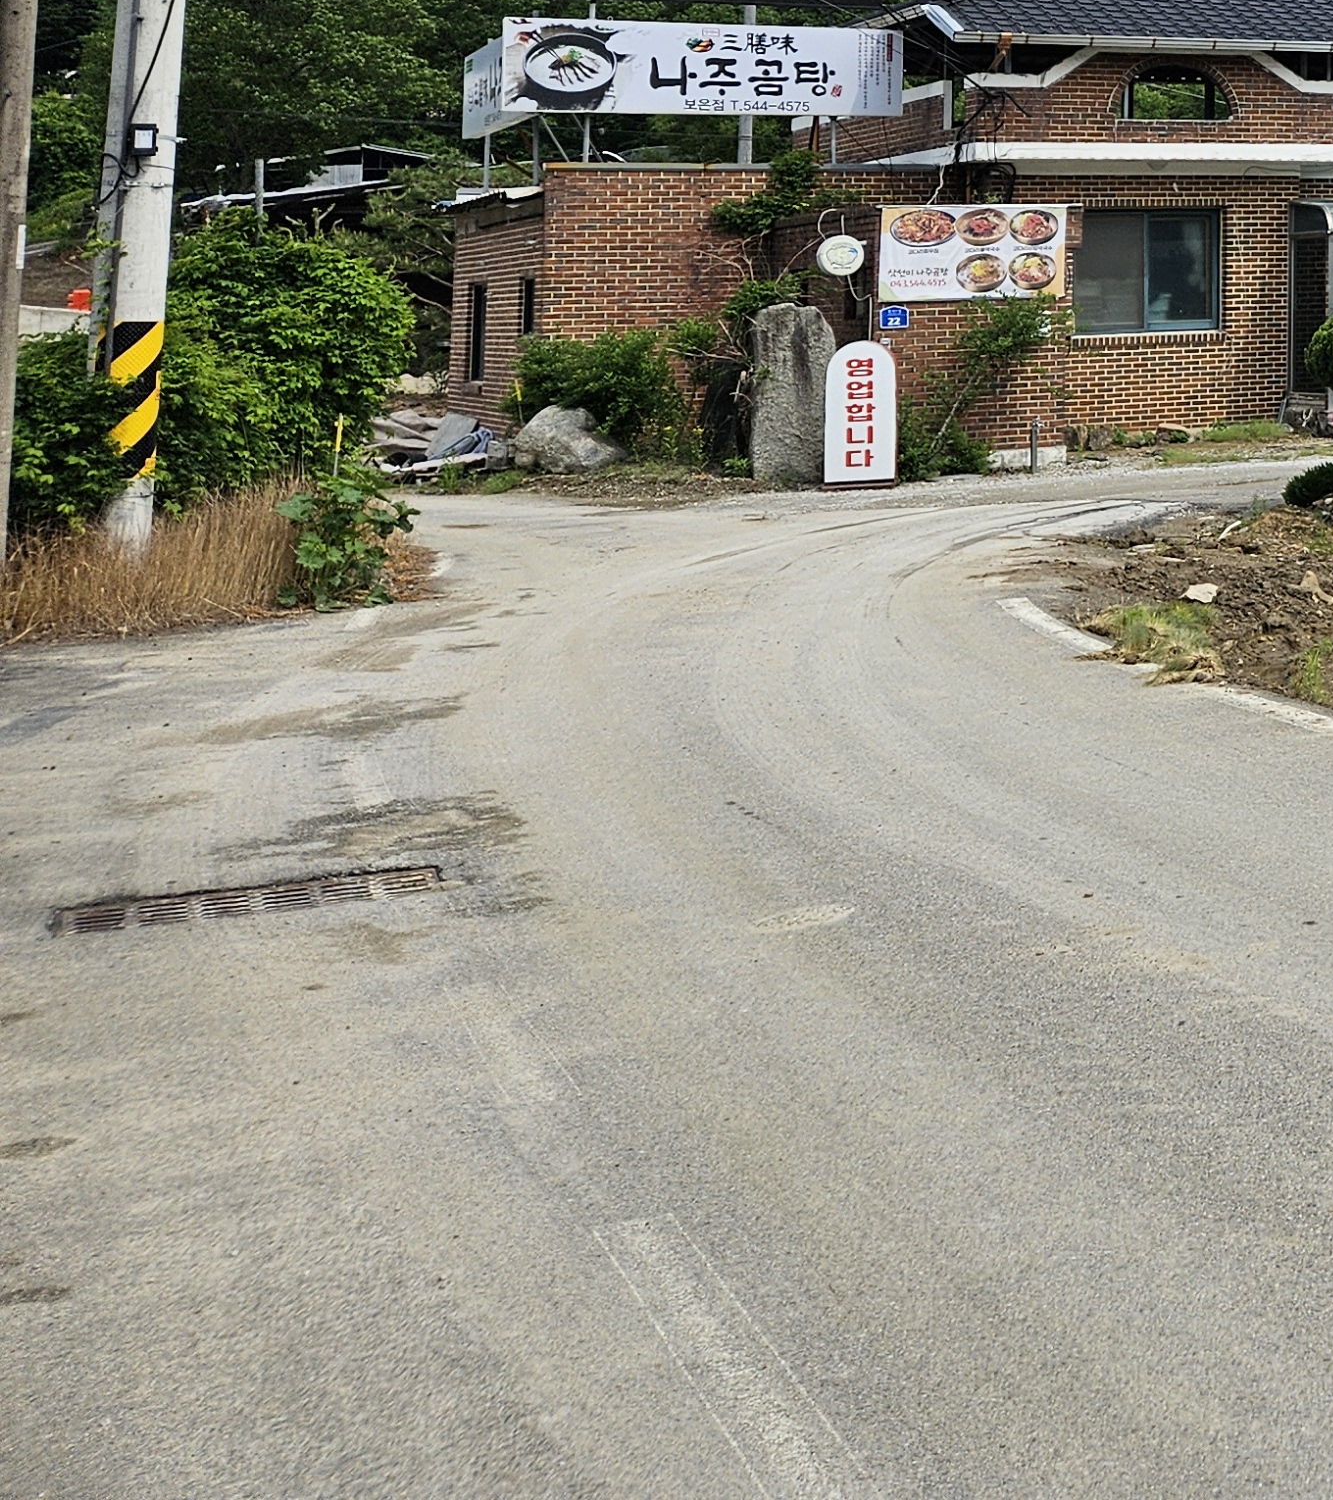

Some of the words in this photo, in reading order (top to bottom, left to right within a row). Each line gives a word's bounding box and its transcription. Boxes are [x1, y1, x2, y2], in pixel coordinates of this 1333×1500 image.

[719, 32, 799, 56] 三膳味
[649, 55, 836, 98] 나주곰탕
[683, 98, 725, 113] 보은점
[731, 100, 810, 113] T.544-4575
[887, 317, 901, 326] 22
[845, 357, 876, 468] 영업합니다
